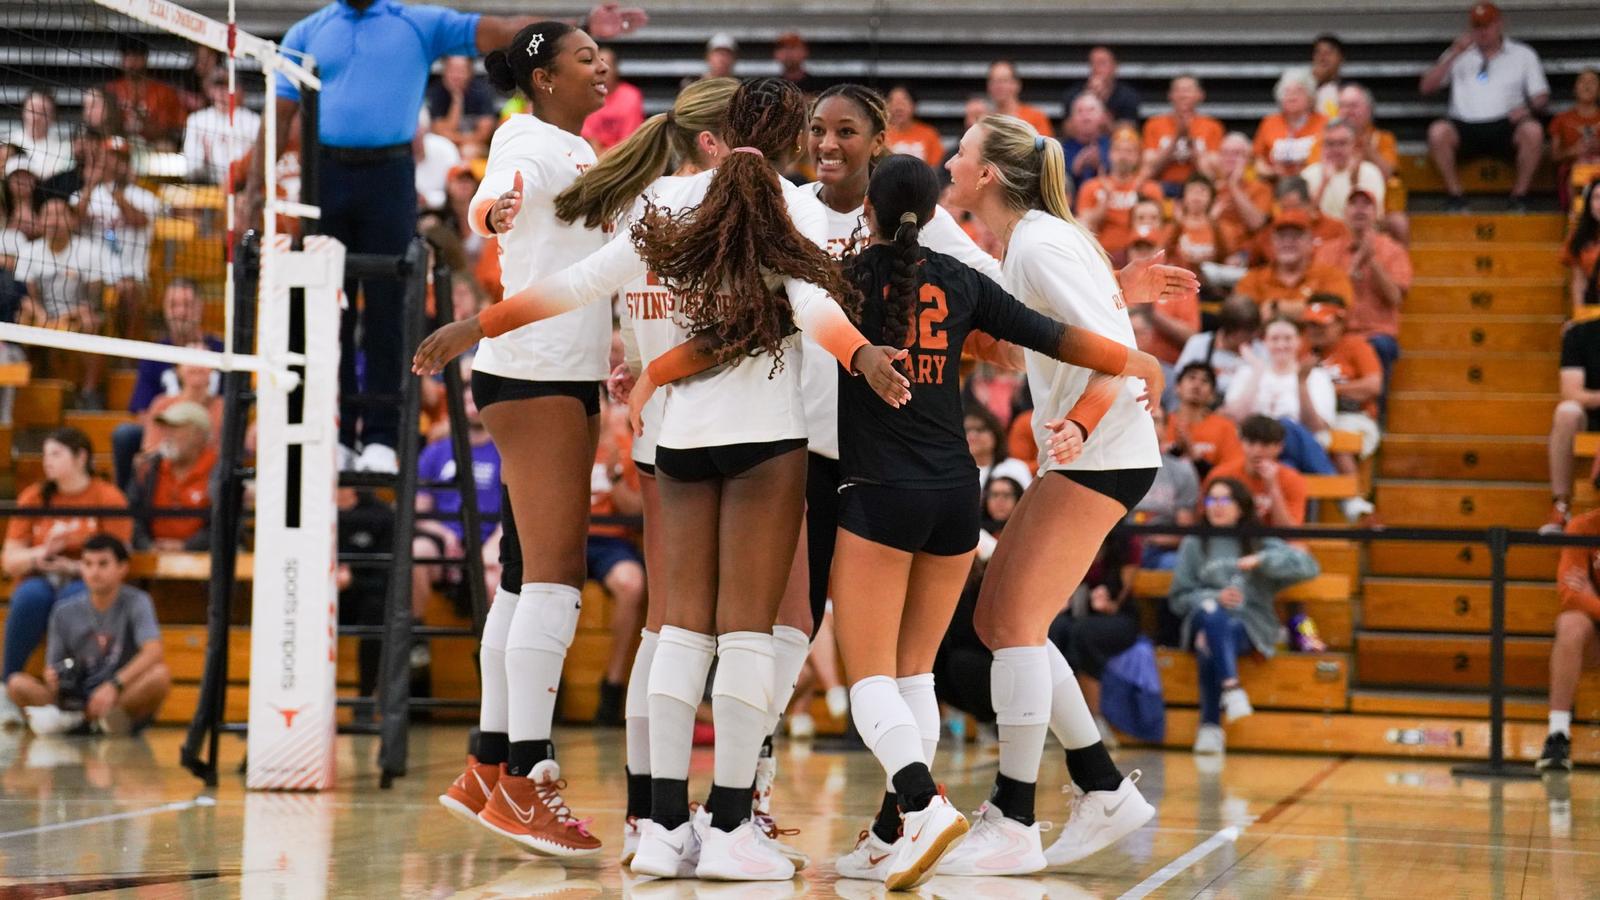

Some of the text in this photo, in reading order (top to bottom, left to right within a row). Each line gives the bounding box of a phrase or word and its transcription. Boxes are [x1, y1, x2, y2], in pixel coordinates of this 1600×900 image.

[882, 282, 949, 350] 2
[900, 353, 947, 384] ARY
[1457, 546, 1473, 563] 4
[1455, 596, 1470, 615] 3
[280, 558, 298, 692] sports imports
[1454, 654, 1470, 671] 2
